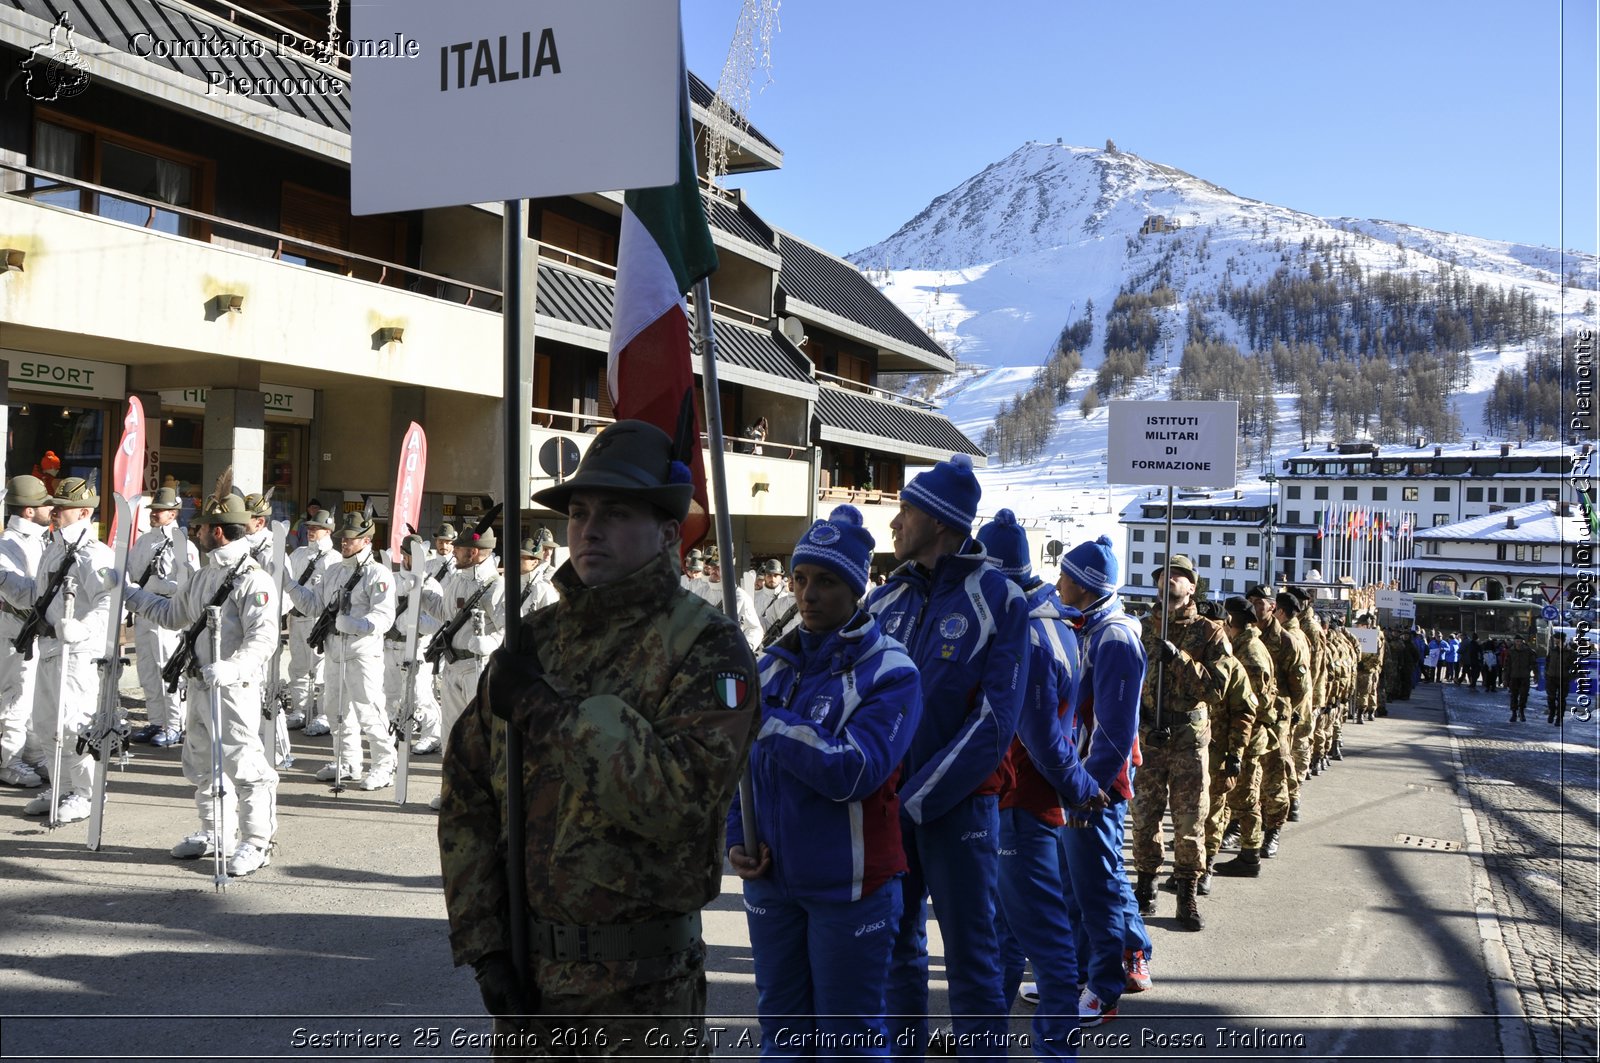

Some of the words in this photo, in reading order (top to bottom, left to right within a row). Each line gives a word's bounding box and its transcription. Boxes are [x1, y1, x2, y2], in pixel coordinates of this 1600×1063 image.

[440, 28, 562, 92] ITALIA
[20, 362, 95, 384] SPORT
[264, 392, 293, 406] ORT
[1146, 416, 1198, 426] ISTITUTI
[1145, 431, 1199, 440] MILITARI
[1165, 446, 1177, 455] DI
[1131, 460, 1211, 471] FORMAZIONE
